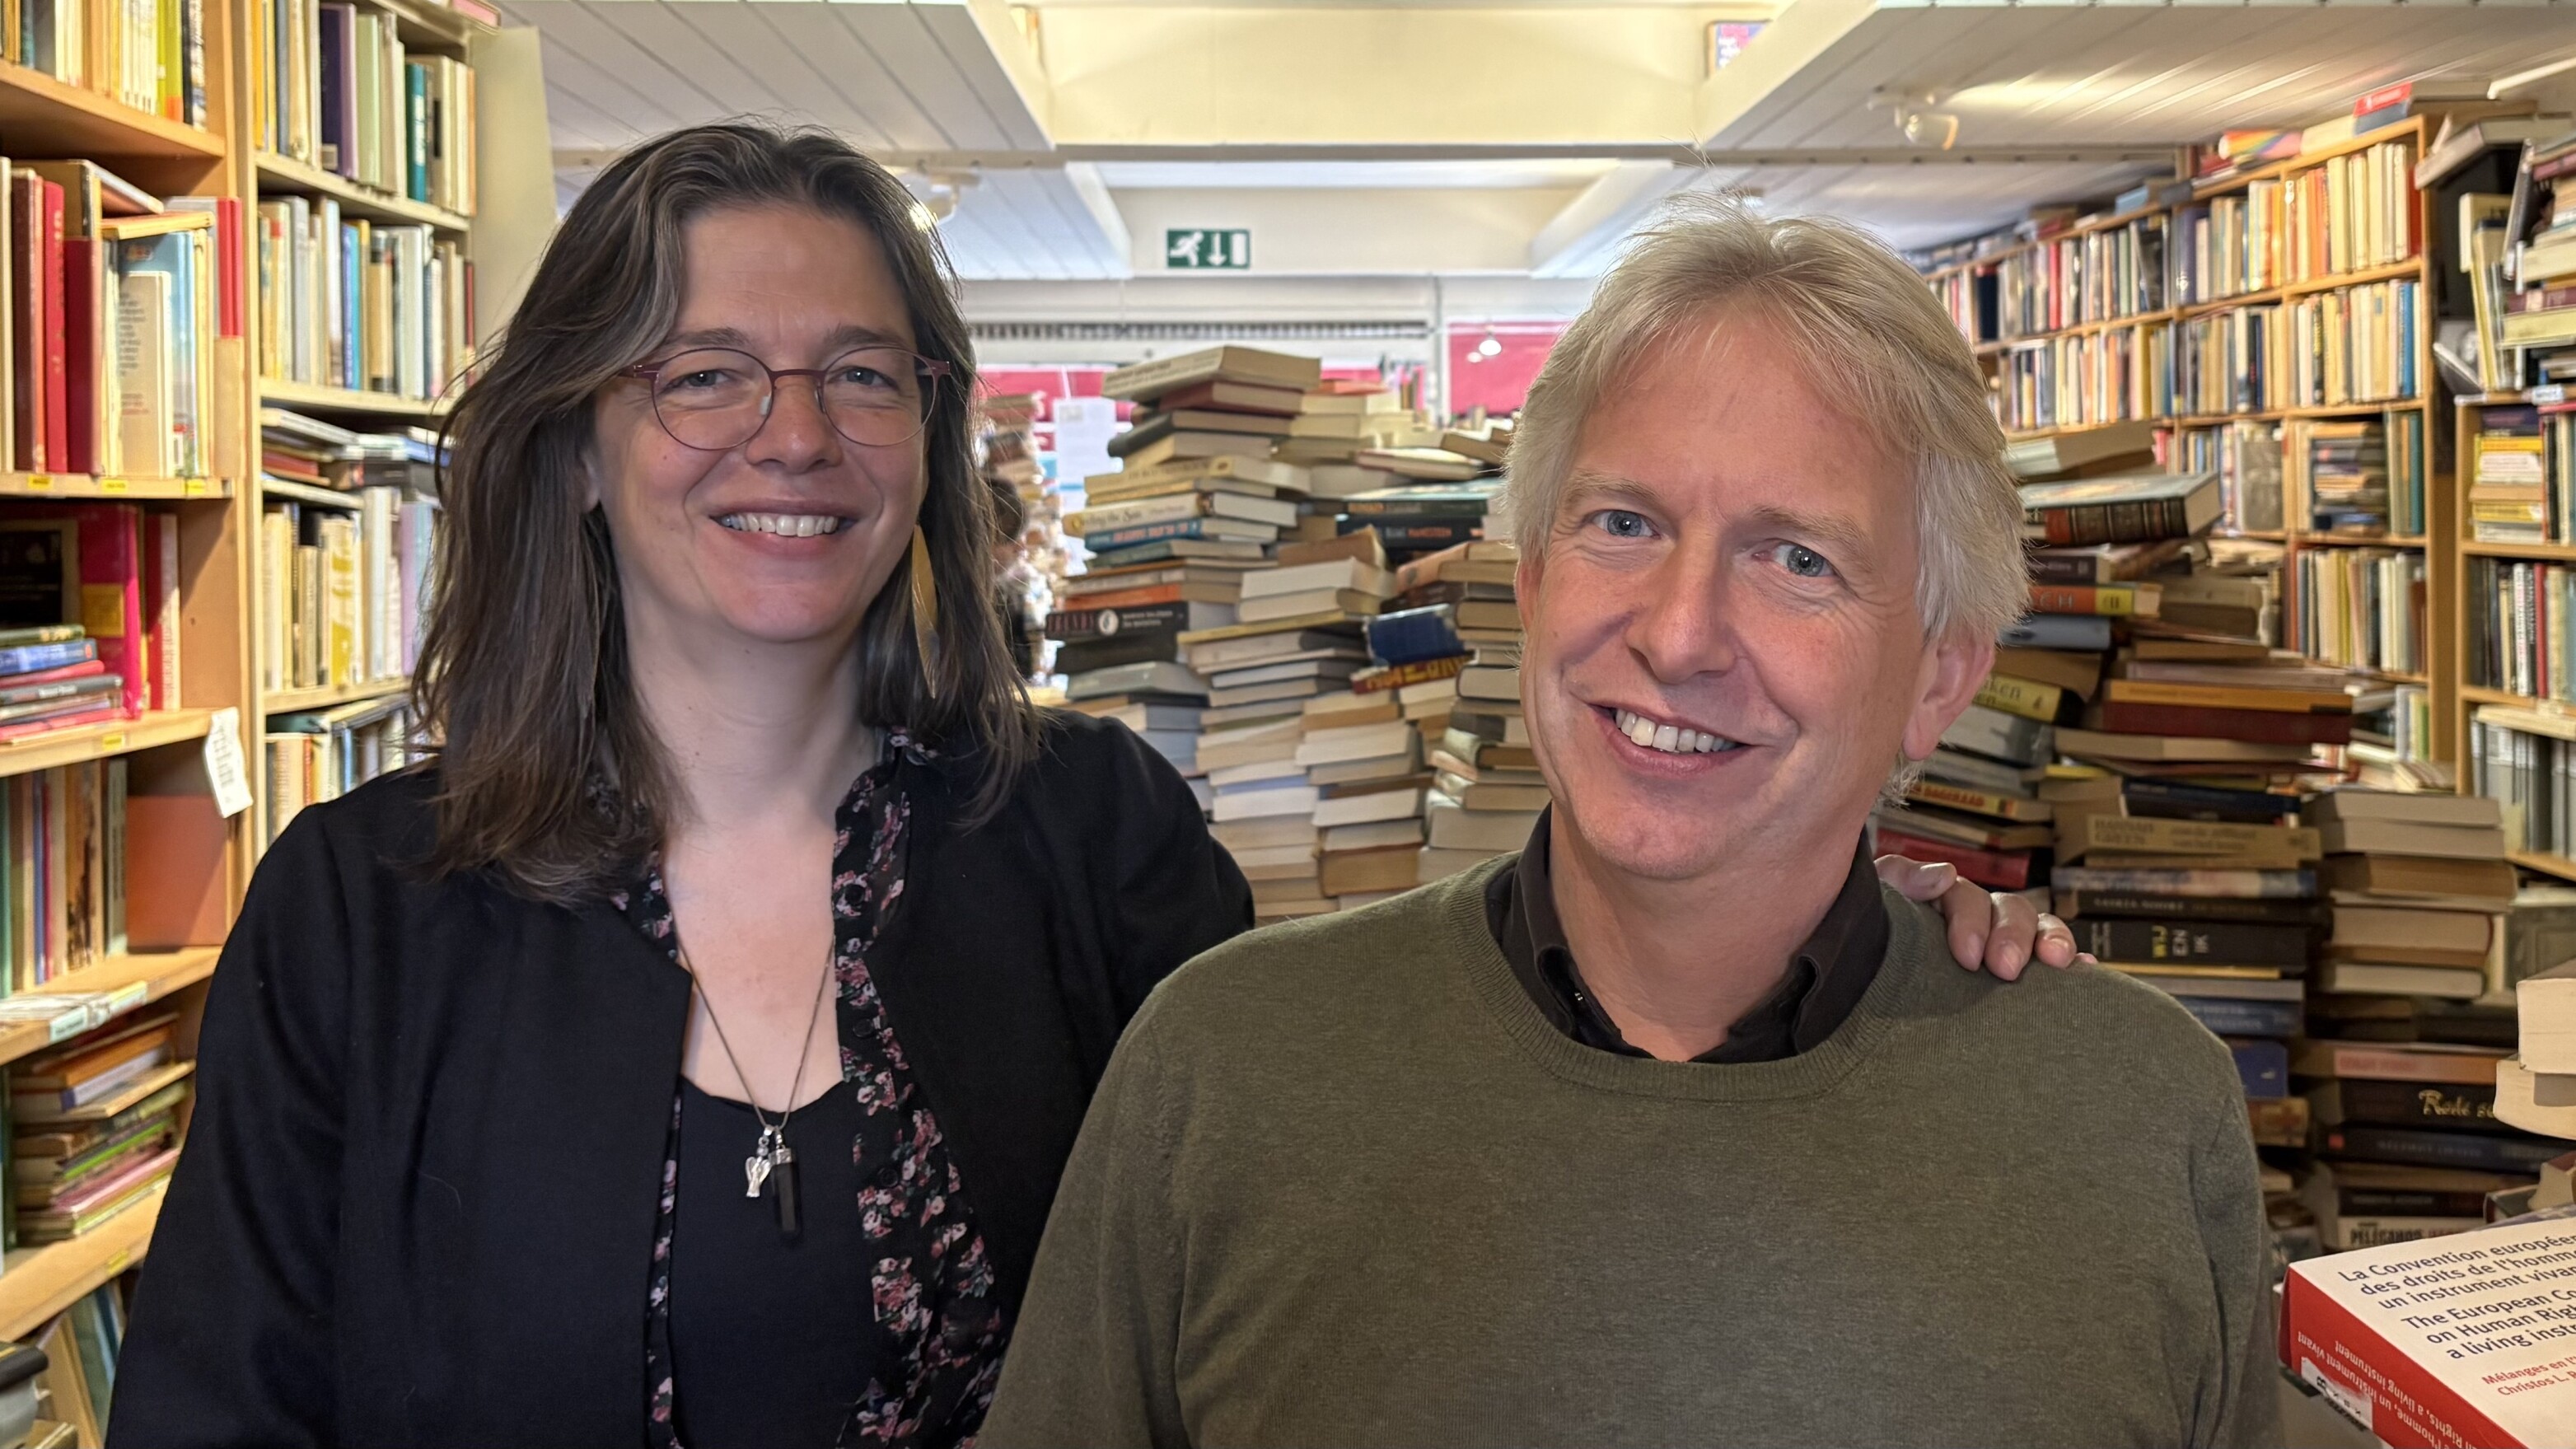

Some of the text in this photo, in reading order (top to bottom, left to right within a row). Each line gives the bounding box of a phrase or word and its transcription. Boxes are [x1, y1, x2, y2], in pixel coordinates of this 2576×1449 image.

[2338, 1270, 2369, 1282] La
[2368, 1250, 2489, 1276] Convention
[2360, 1250, 2576, 1296] des droits de l'homm
[2378, 1296, 2409, 1309] un
[2405, 1274, 2529, 1303] instrument
[2401, 1316, 2449, 1329] The
[2447, 1295, 2553, 1320] European
[2298, 1330, 2325, 1359] vivant
[2426, 1330, 2458, 1344] on
[2455, 1315, 2538, 1337] Human
[2446, 1349, 2466, 1359] a
[2460, 1334, 2533, 1355] living
[2326, 1353, 2377, 1403] instrument
[2335, 1340, 2387, 1391] instrument
[2481, 1364, 2549, 1385] Mélanges
[2549, 1360, 2568, 1369] en
[2387, 1379, 2415, 1413] living
[2497, 1378, 2555, 1395] Christos
[2552, 1374, 2570, 1382] L.
[2379, 1394, 2391, 1411] un
[2418, 1405, 2424, 1416] a
[2426, 1409, 2463, 1449] Rights,
